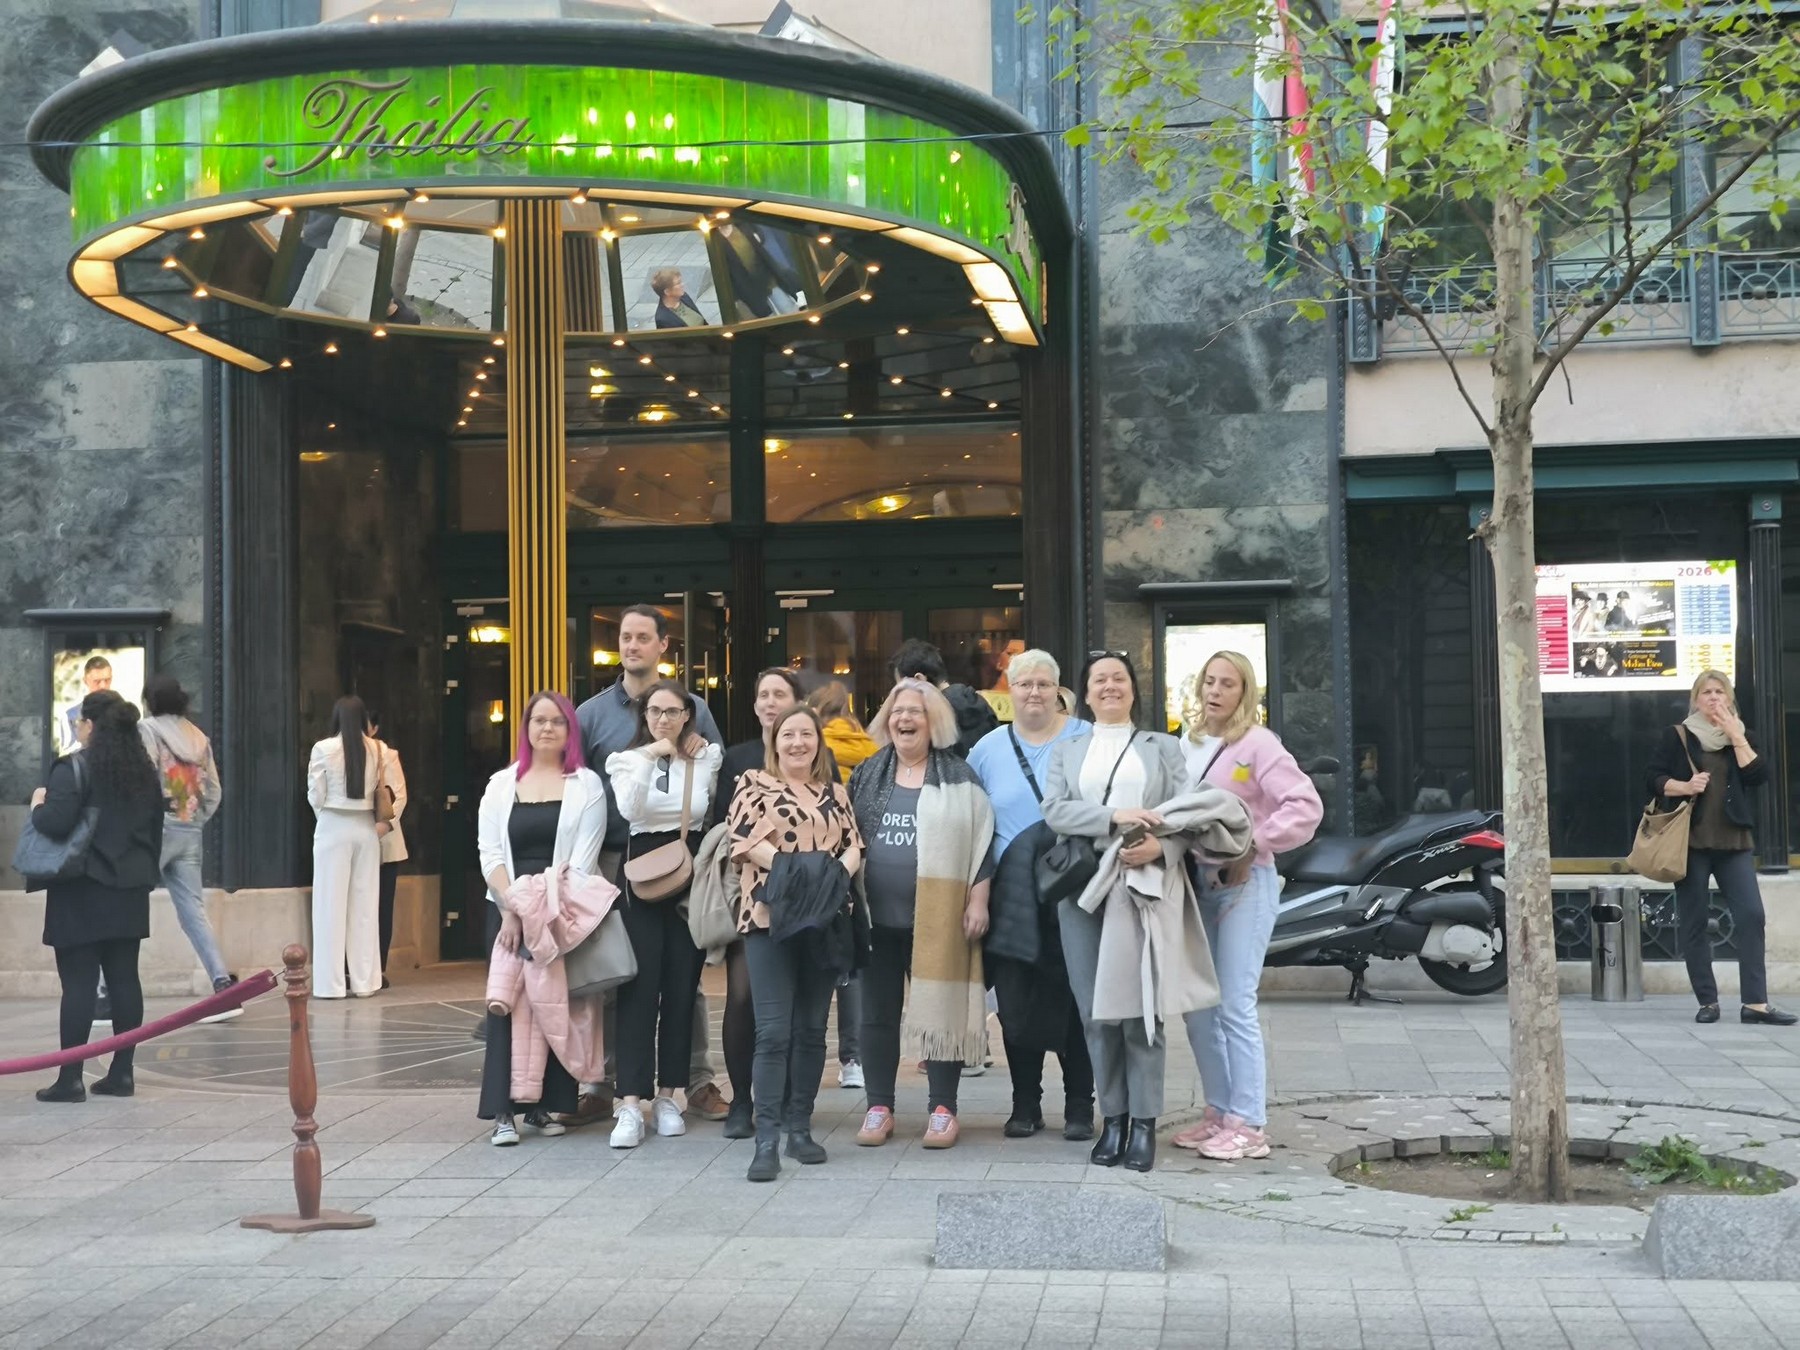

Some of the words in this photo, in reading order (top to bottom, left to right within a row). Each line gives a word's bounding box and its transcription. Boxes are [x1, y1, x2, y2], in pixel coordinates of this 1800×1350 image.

[264, 76, 536, 177] Thália
[1677, 567, 1713, 577] 2026
[885, 831, 917, 846] LOV
